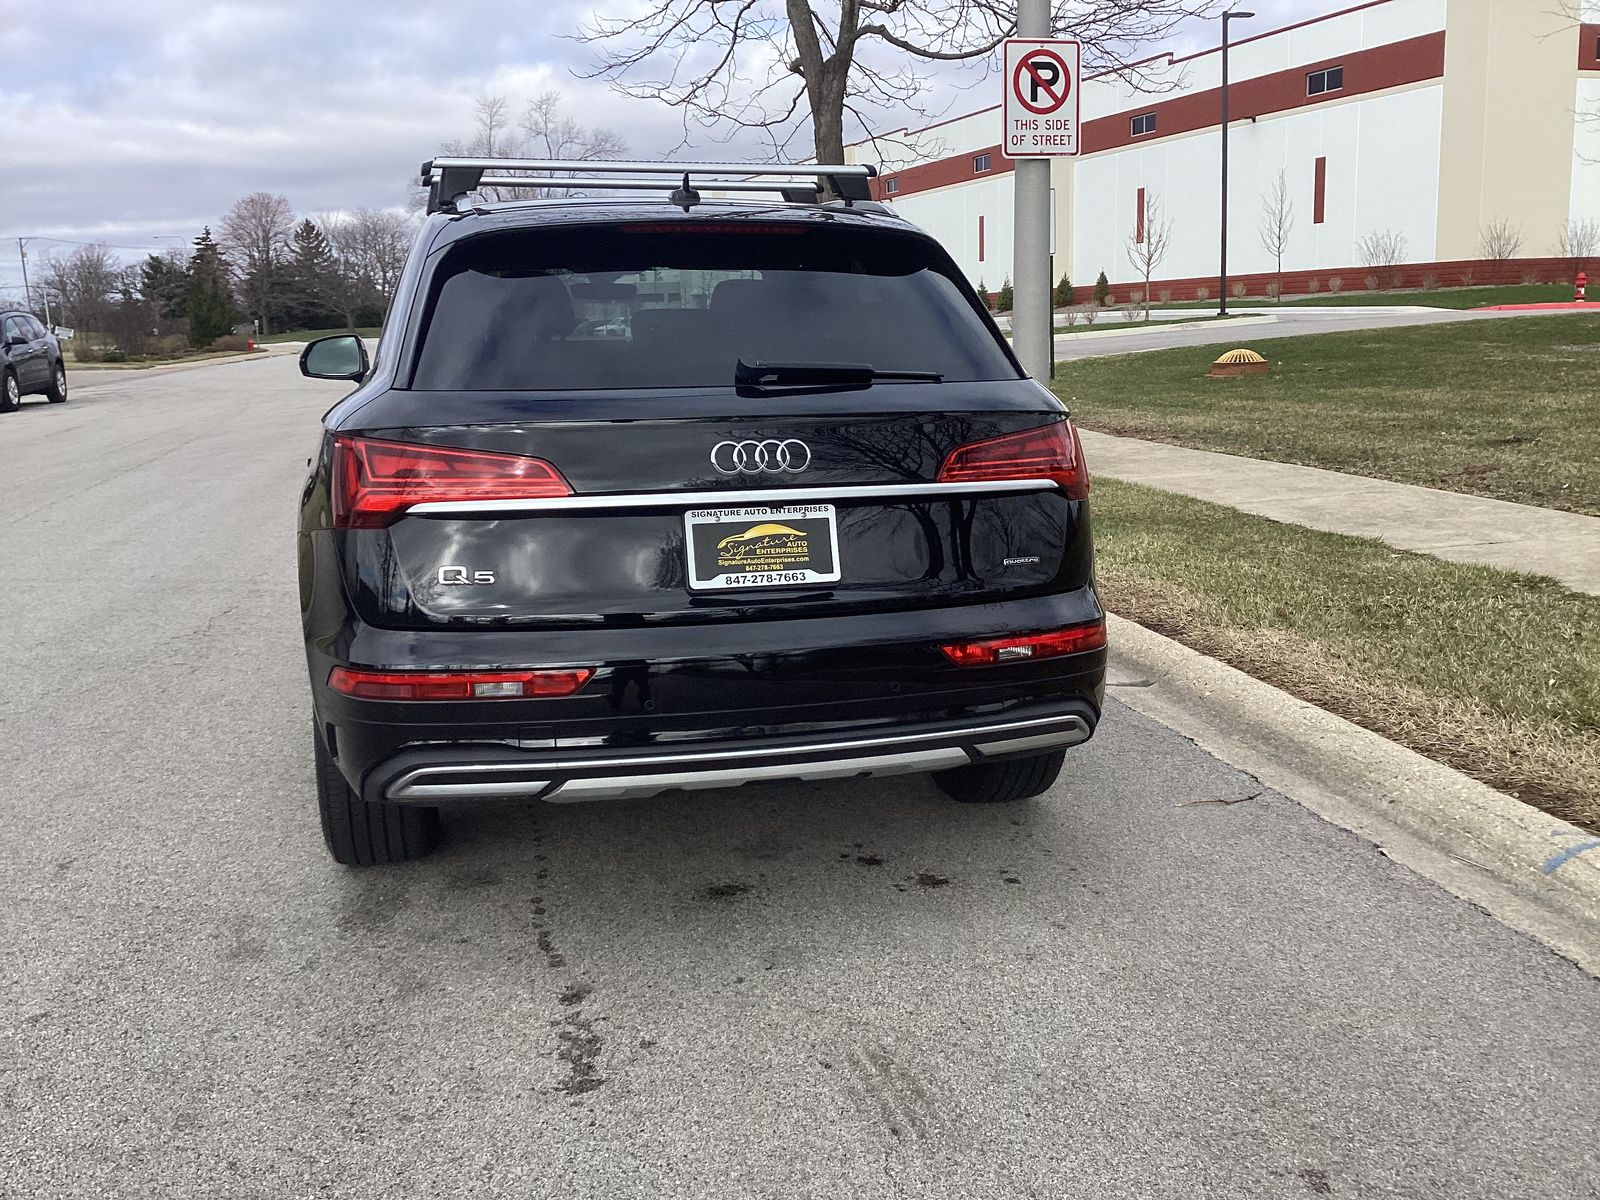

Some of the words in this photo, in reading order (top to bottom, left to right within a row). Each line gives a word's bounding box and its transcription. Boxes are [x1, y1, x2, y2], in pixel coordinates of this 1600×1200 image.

[1014, 119, 1039, 131] THIS
[1045, 119, 1070, 131] SIDE
[1011, 134, 1026, 146] OF
[1032, 134, 1072, 146] STREET
[691, 509, 741, 518] SIGNATURE
[744, 508, 768, 516] AUTO
[770, 505, 829, 515] ENTERPRISES
[720, 534, 798, 560] Signature
[756, 546, 809, 555] ENTERPRISES
[718, 556, 810, 566] SignatureAutoEnterprises.com
[438, 566, 495, 585] Q5
[725, 572, 807, 585] 847-278-7663
